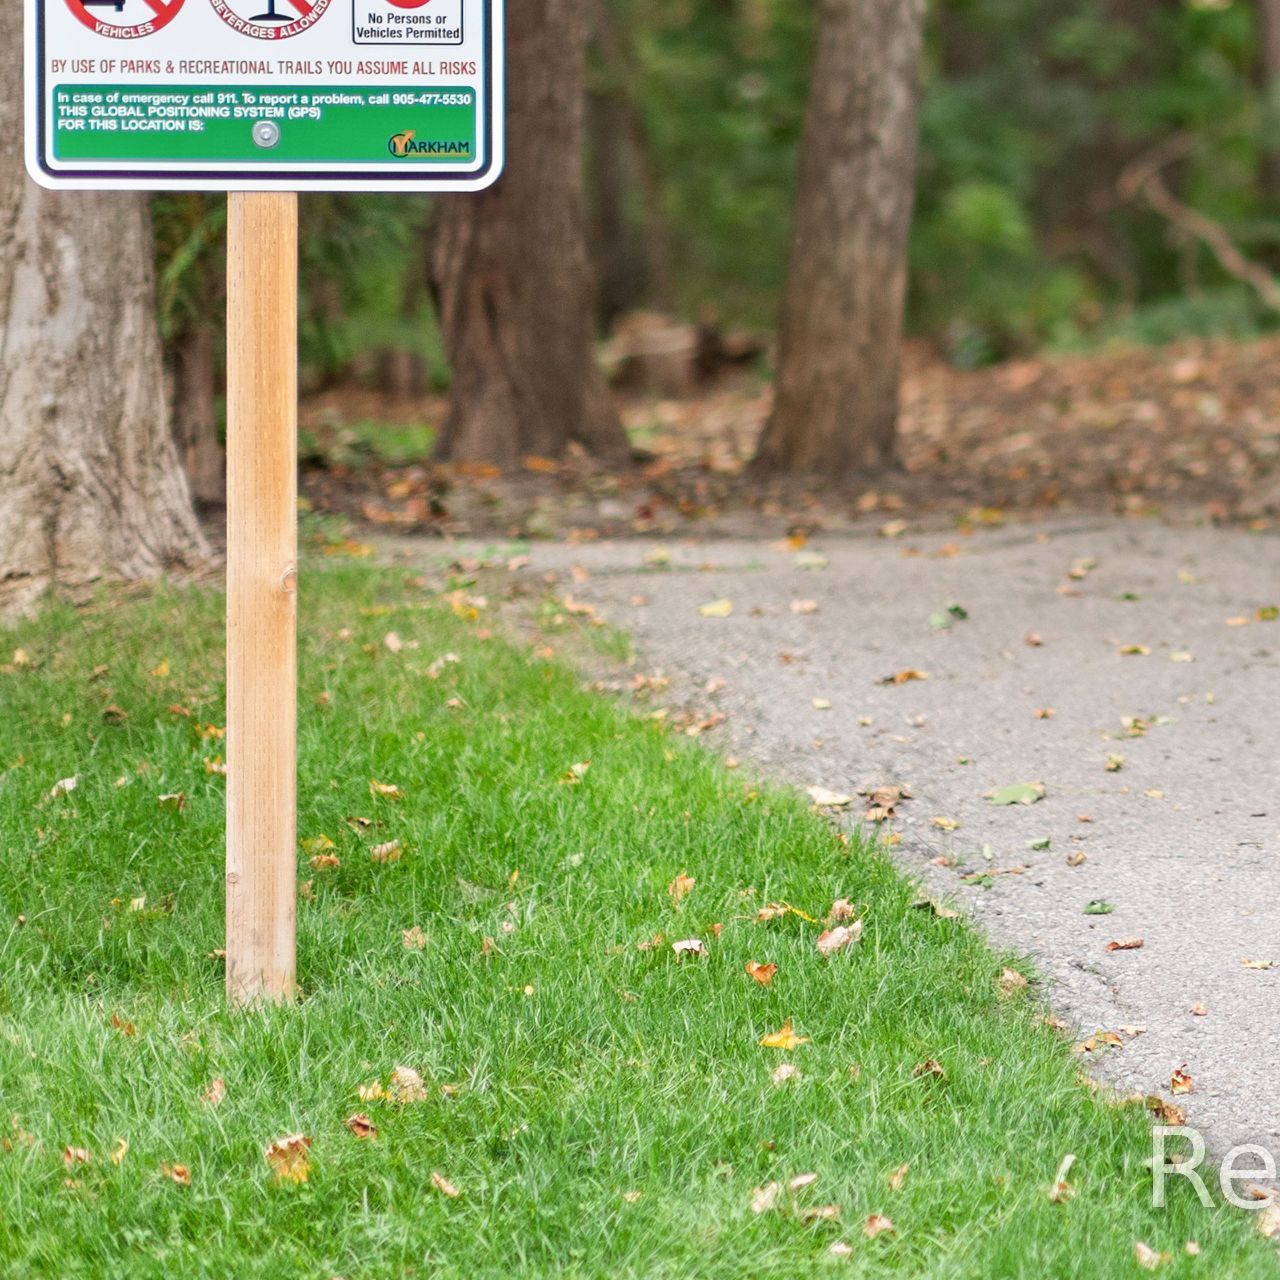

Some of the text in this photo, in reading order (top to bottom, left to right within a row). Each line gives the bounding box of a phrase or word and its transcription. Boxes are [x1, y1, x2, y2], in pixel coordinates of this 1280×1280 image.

[368, 13, 446, 24] No Persons or
[95, 22, 154, 38] VEHICLES
[356, 27, 459, 39] Vehicles Permitted
[51, 59, 476, 75] BY USE OF PARKS & RECREATIONAL TRAILS YOU ASSUME ALL RISKS
[57, 92, 471, 106] In case of emergency call 911. To report a problem, call 905-477-5530
[58, 106, 321, 120] THIS GLOBAL POSITIONING SYSTEM (GPS)
[58, 120, 204, 131] FOR THIS LOCATION IS:
[388, 130, 470, 158] MARKHAM
